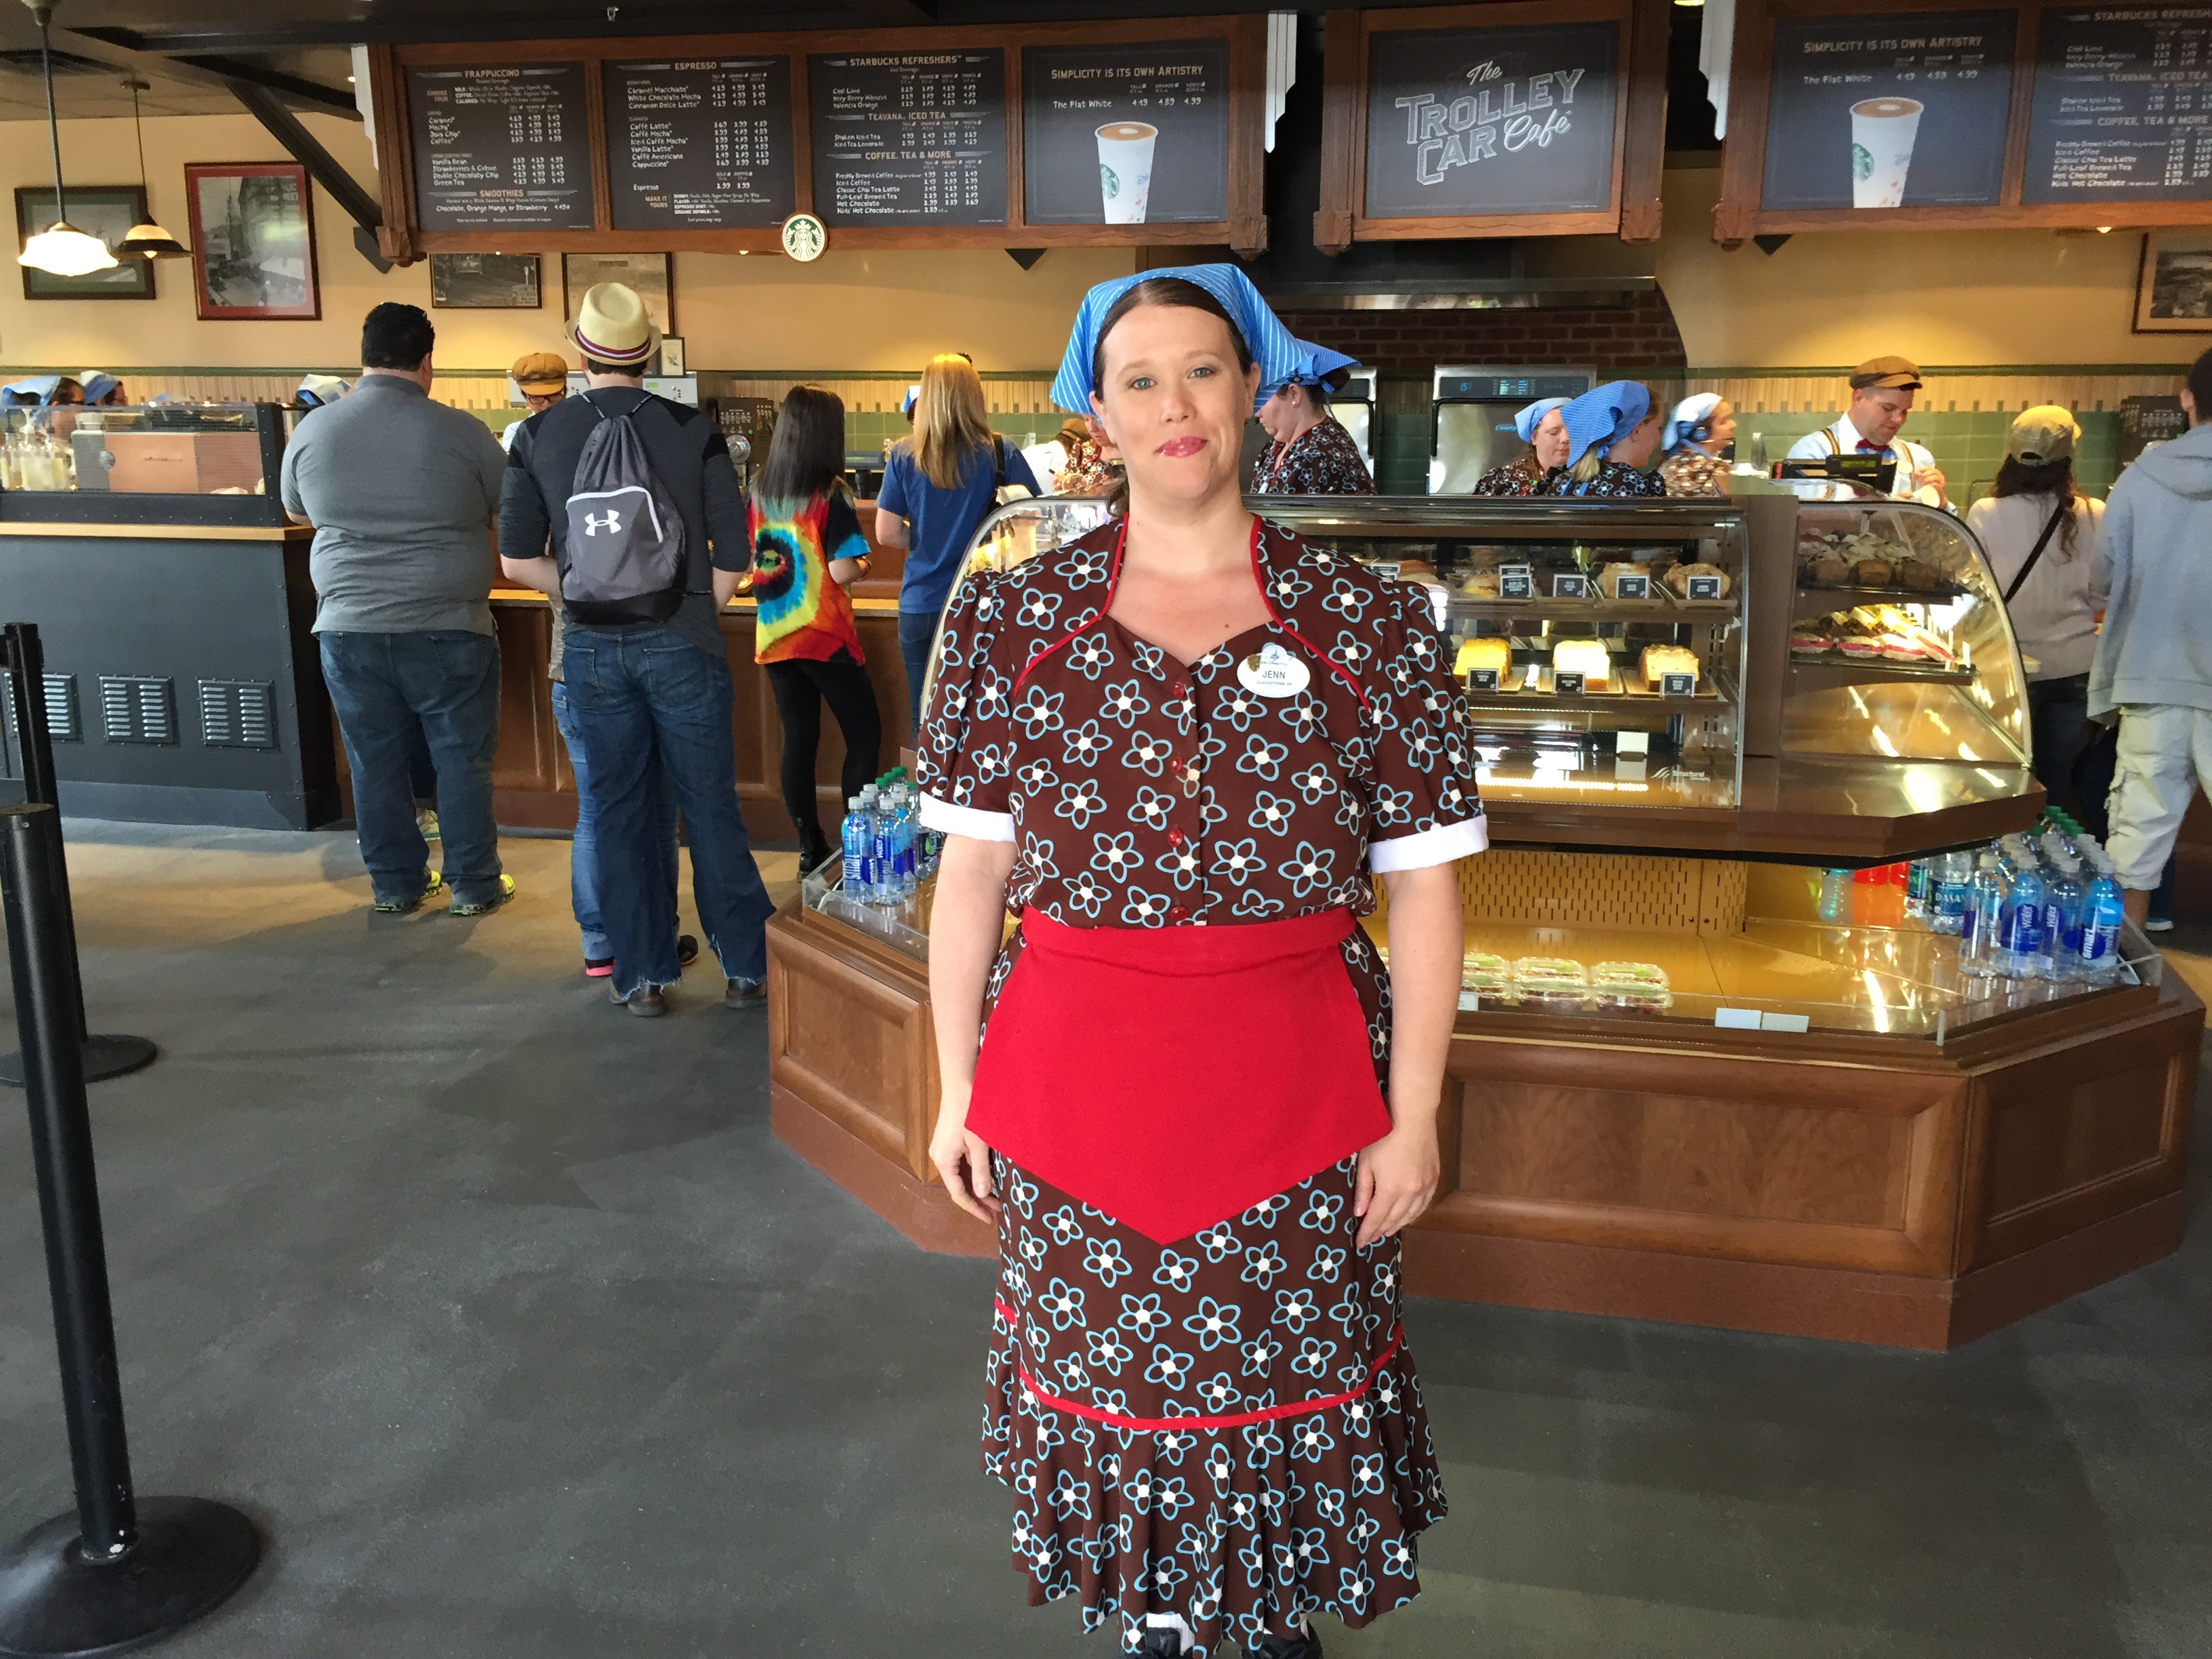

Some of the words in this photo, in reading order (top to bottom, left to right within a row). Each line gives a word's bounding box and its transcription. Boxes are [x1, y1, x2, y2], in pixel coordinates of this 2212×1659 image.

[1803, 41, 1863, 53] SIMPLICITY
[1866, 40, 1877, 50] IS
[1880, 39, 1898, 49] ITS
[1901, 39, 1925, 49] OWN
[674, 61, 717, 70] ESPRESSO
[850, 57, 899, 67] STARBUCKS
[464, 69, 520, 78] FRAPPUCCINO
[1051, 69, 1101, 79] SIMPLICITY
[1105, 68, 1113, 78] IS
[1116, 68, 1131, 77] ITS
[1134, 66, 1154, 77] OWN
[1158, 65, 1203, 76] ARTISTRY
[1467, 60, 1502, 86] The
[857, 102, 879, 110] Orange
[1052, 100, 1067, 108] The
[1069, 100, 1086, 108] Flat
[1088, 100, 1111, 108] White
[1395, 68, 1585, 144] TROLLEY
[908, 112, 928, 120] ICED
[929, 111, 946, 120] TEA
[1416, 125, 1497, 186] CAR
[1503, 108, 1572, 152] Café
[901, 151, 917, 159] TEA
[919, 150, 926, 159] &
[927, 150, 951, 159] MORE
[633, 184, 659, 192] Espresso
[479, 189, 524, 197] SMOOTHIES
[1263, 670, 1286, 679] JENN
[876, 838, 884, 859] water
[2022, 904, 2032, 928] water
